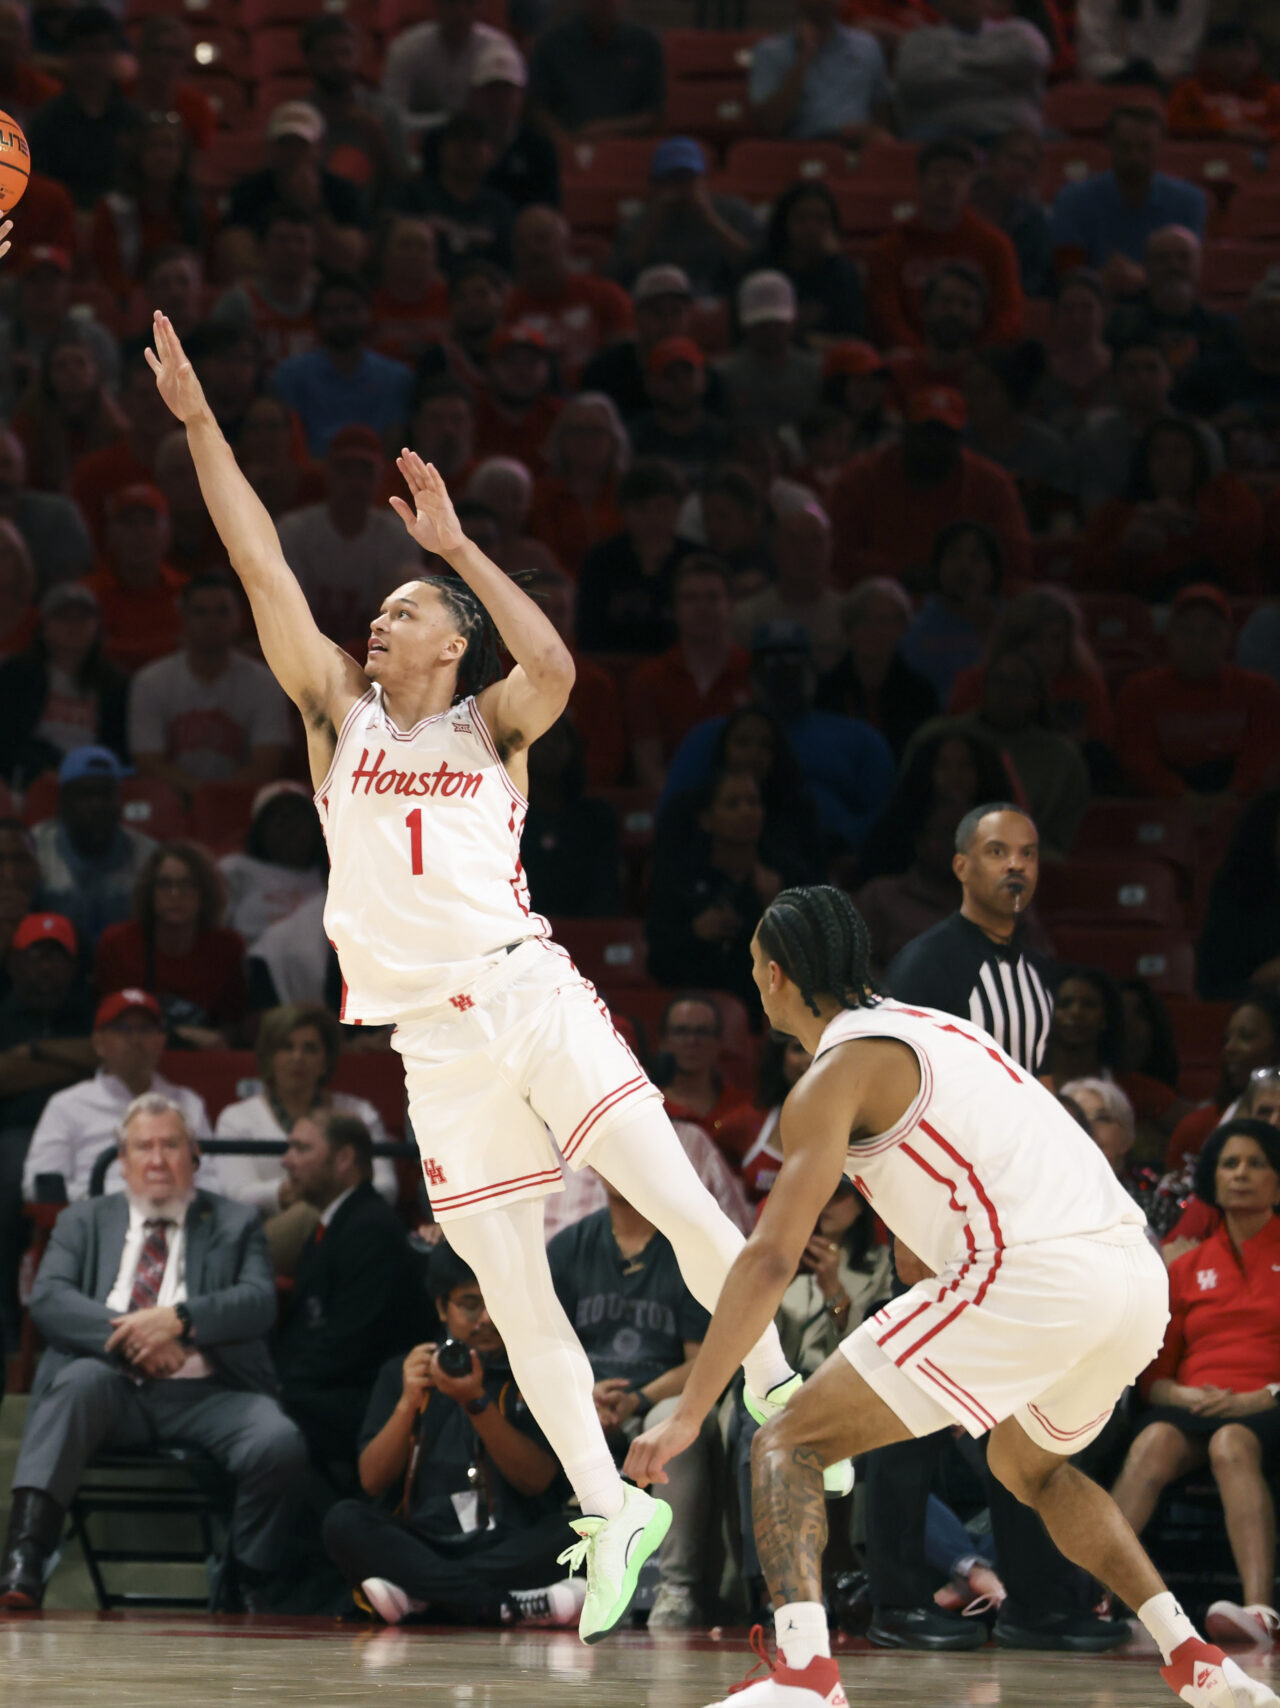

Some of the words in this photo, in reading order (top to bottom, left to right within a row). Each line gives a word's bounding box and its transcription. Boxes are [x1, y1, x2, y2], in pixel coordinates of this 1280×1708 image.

[351, 747, 483, 799] Houston
[405, 808, 424, 876] 1
[423, 1157, 448, 1186] UH
